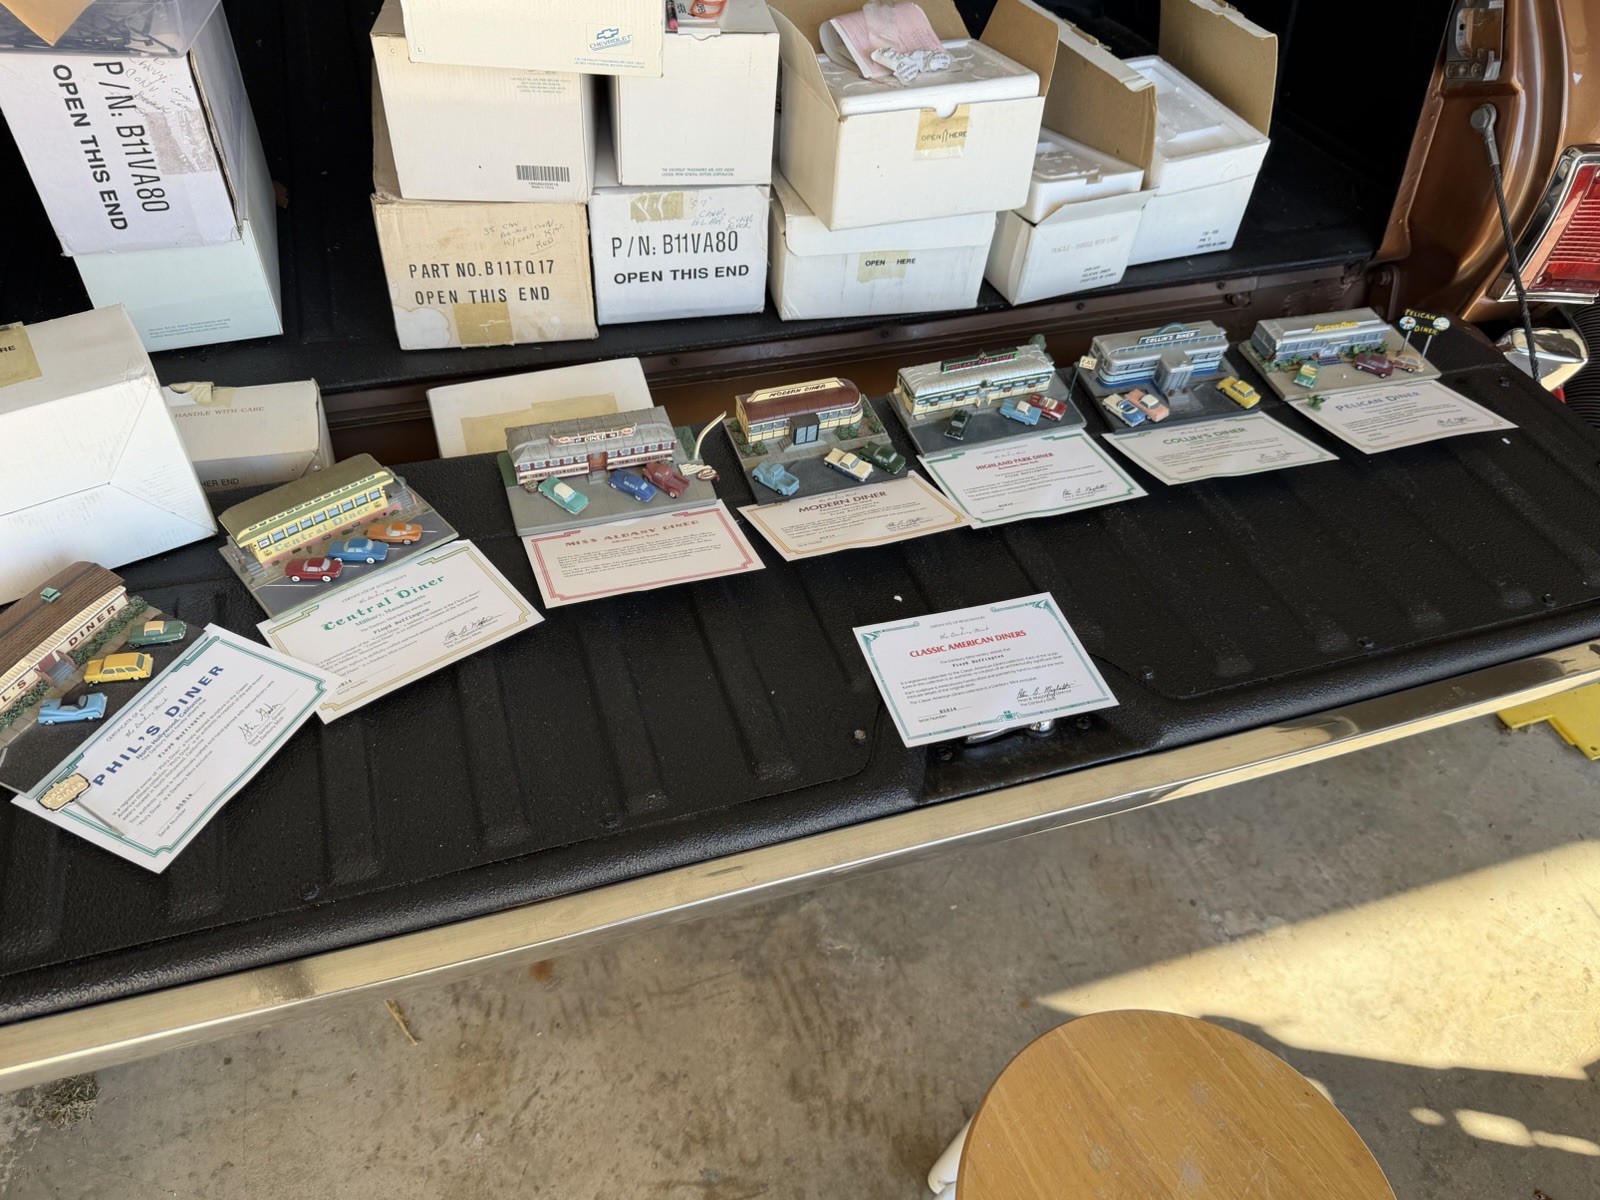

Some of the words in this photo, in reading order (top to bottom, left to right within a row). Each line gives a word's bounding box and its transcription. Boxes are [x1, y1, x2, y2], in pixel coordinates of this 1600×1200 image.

[589, 34, 633, 49] CHEVROLET
[949, 130, 968, 139] HERE
[52, 64, 91, 127] OPEN
[80, 135, 110, 183] THIS
[99, 190, 128, 230] END
[116, 125, 170, 212] B11VA80
[663, 230, 738, 255] B11VA80
[409, 263, 449, 278] PART
[456, 262, 481, 277] NO.
[484, 259, 554, 276] B11TQ17
[896, 257, 916, 265] HERE
[614, 270, 663, 285] OPEN
[670, 267, 709, 281] THIS
[714, 264, 750, 278] END
[415, 290, 458, 305] OPEN
[468, 288, 507, 304] THIS
[519, 286, 550, 301] END
[1404, 308, 1437, 321] PELICAN
[1176, 332, 1196, 340] DINER
[1413, 324, 1438, 335] DINER
[769, 388, 801, 398] MODERN
[1332, 398, 1387, 411] PELICAN
[1383, 391, 1423, 401] DINER
[174, 410, 212, 418] HANDLE
[199, 479, 218, 488] HER
[221, 477, 240, 486] END
[796, 498, 851, 512] MODERN
[850, 490, 888, 501] DINER
[564, 537, 598, 547] MISS
[319, 596, 393, 632] Central
[395, 573, 447, 599] Diner
[68, 604, 117, 648] DINER
[908, 645, 947, 658] CLASSIC
[946, 636, 995, 650] AMERICAN
[994, 629, 1027, 641] DINERS
[90, 723, 162, 786] PHIL'S
[163, 664, 225, 718] DINER
[135, 744, 153, 759] North
[150, 717, 181, 744] Hollywood,
[177, 695, 203, 718] California
